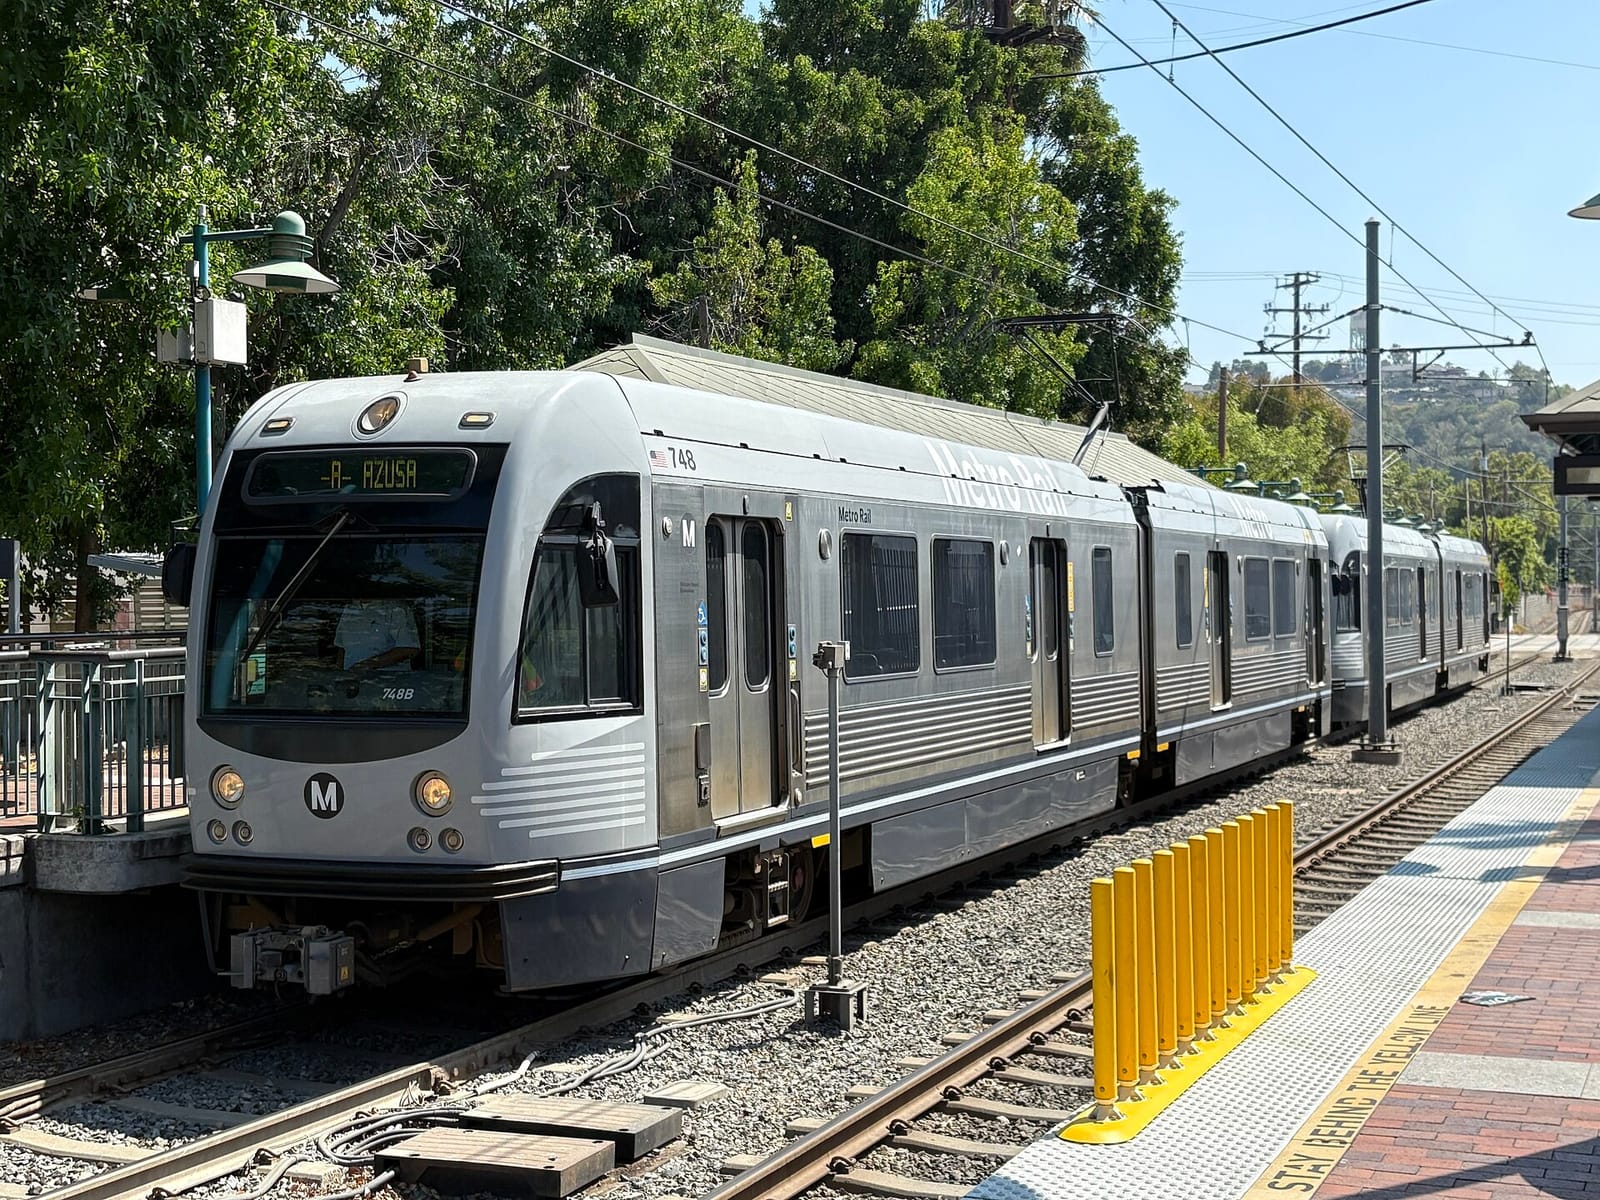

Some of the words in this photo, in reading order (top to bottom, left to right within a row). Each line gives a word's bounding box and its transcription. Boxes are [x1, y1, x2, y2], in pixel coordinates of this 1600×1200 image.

[668, 446, 697, 471] 748
[363, 459, 417, 489] AZUSA
[923, 438, 1021, 510] Metro
[1008, 455, 1068, 516] Rail
[838, 506, 859, 523] Metro
[859, 508, 872, 524] Rail
[682, 519, 696, 548] M
[382, 687, 415, 700] 748B
[311, 780, 338, 811] M
[1404, 1004, 1450, 1025] LINE
[1368, 1026, 1435, 1068] YELLOW
[1346, 1069, 1400, 1091] THE
[1302, 1097, 1378, 1149] BEHIND
[1267, 1152, 1334, 1193] STAY
